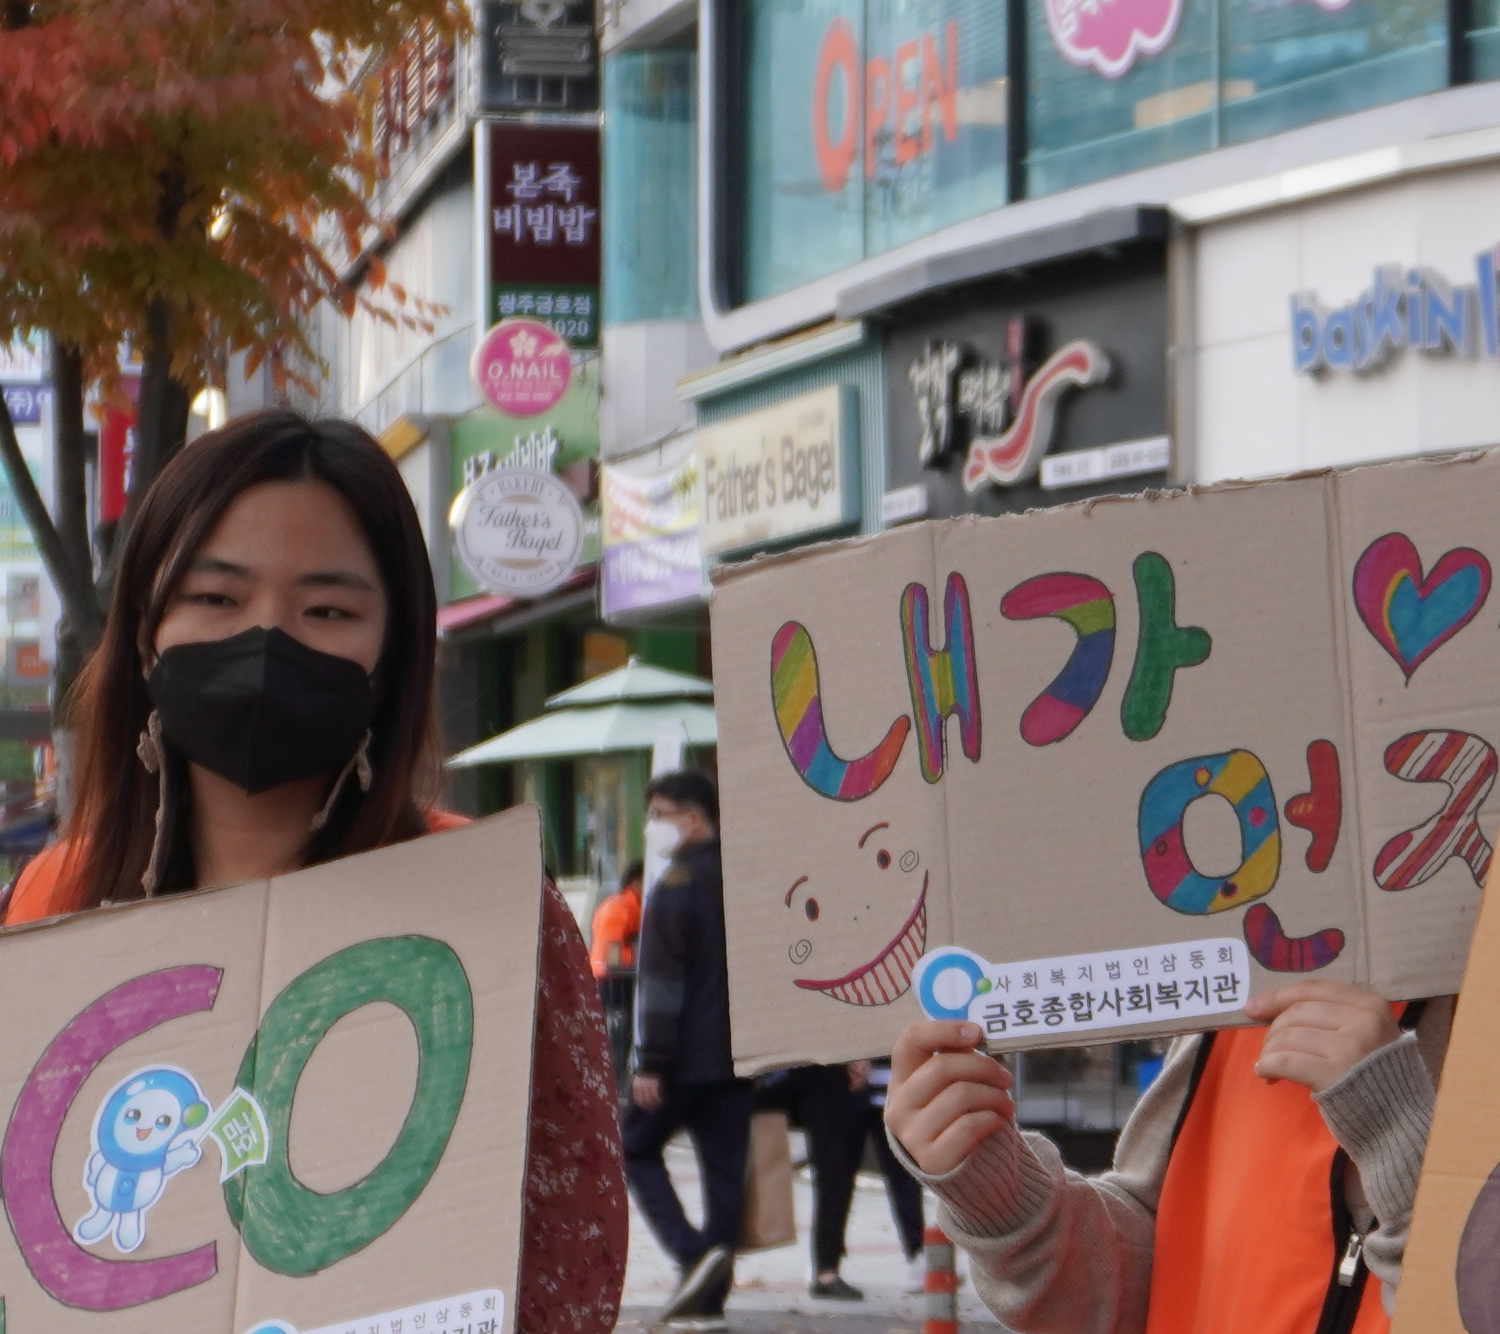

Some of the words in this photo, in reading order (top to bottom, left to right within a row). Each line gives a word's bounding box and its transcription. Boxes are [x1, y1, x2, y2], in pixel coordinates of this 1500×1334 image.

[813, 18, 962, 193] OPEN
[506, 162, 580, 201] 본죽
[494, 203, 596, 244] 비빔밥
[498, 293, 591, 317] 광주금호점
[1291, 270, 1467, 370] baskin
[488, 361, 562, 380] O.NAIL
[706, 433, 777, 524] Father's
[781, 422, 837, 510] Bagel
[478, 505, 552, 528] Father's
[505, 528, 564, 558] Bagel
[770, 549, 1212, 802] 내가
[981, 971, 1242, 1035] 금호종합사회복지관
[222, 1110, 259, 1160] 금호
